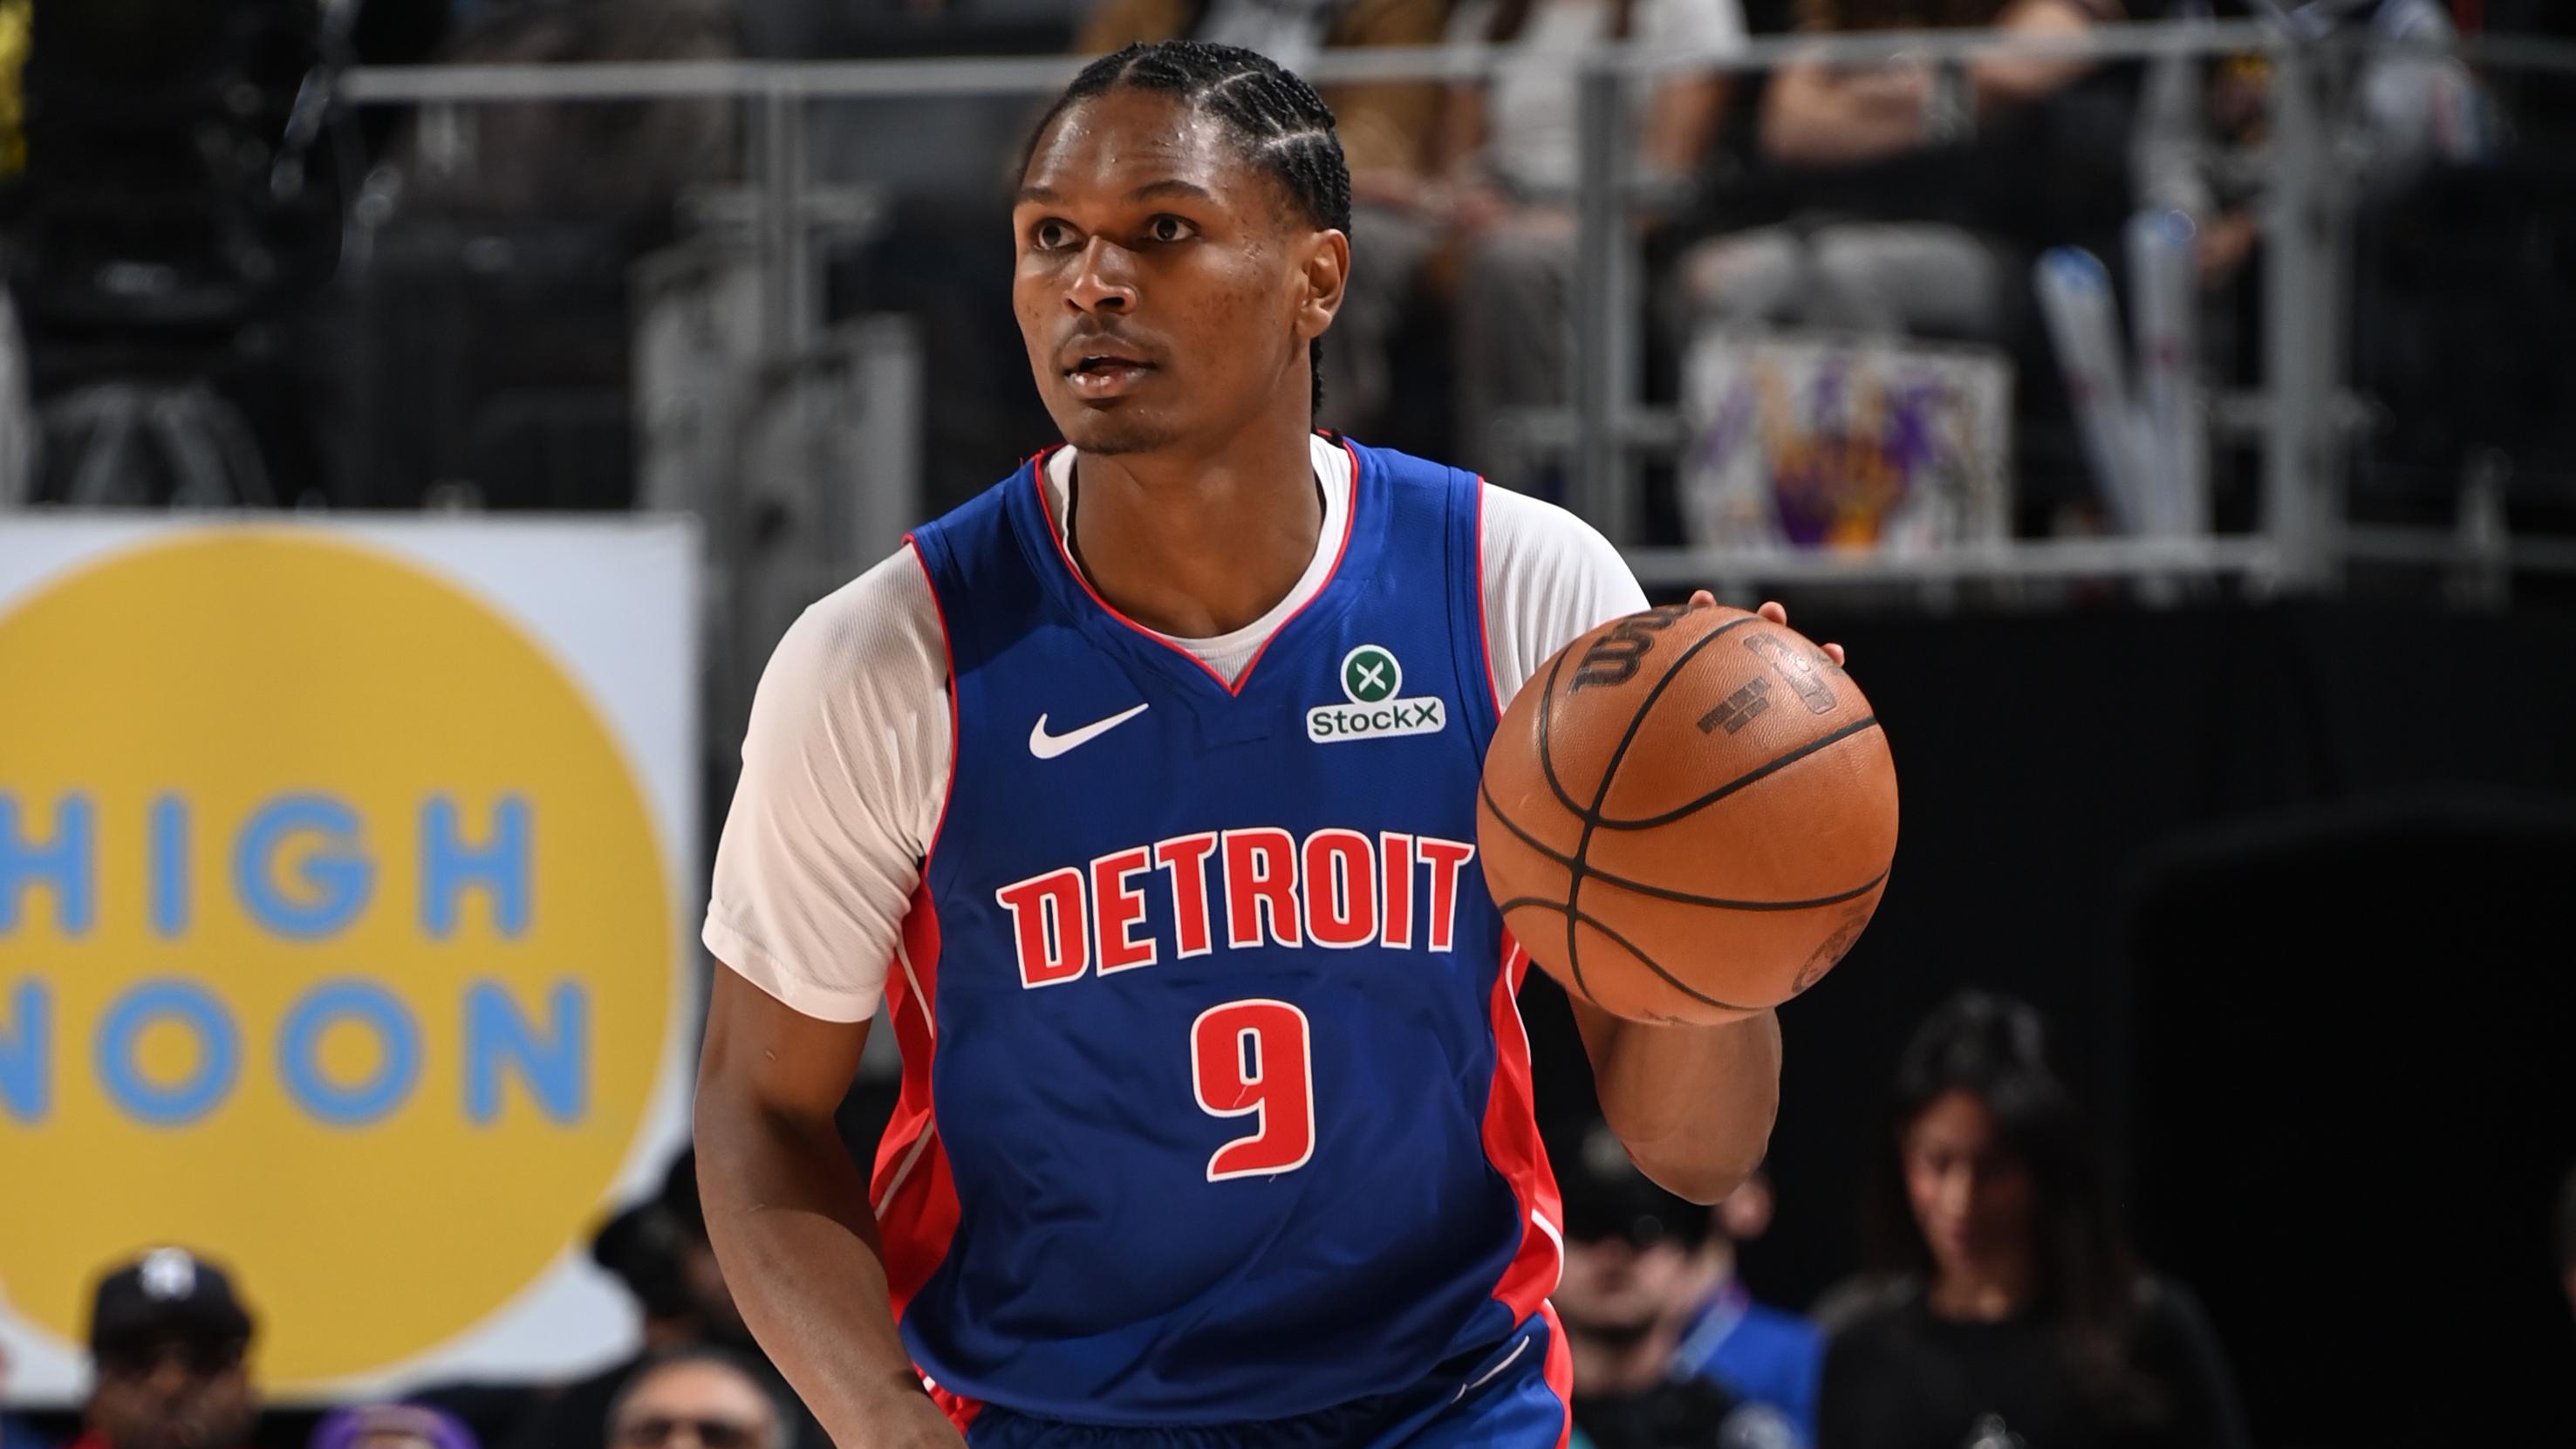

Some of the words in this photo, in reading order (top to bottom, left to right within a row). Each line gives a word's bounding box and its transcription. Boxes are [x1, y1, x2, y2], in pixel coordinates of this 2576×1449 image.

[1312, 701, 1438, 736] StockX
[0, 793, 532, 940] HIGH
[996, 827, 1475, 989] DETROIT
[1191, 998, 1315, 1182] 9
